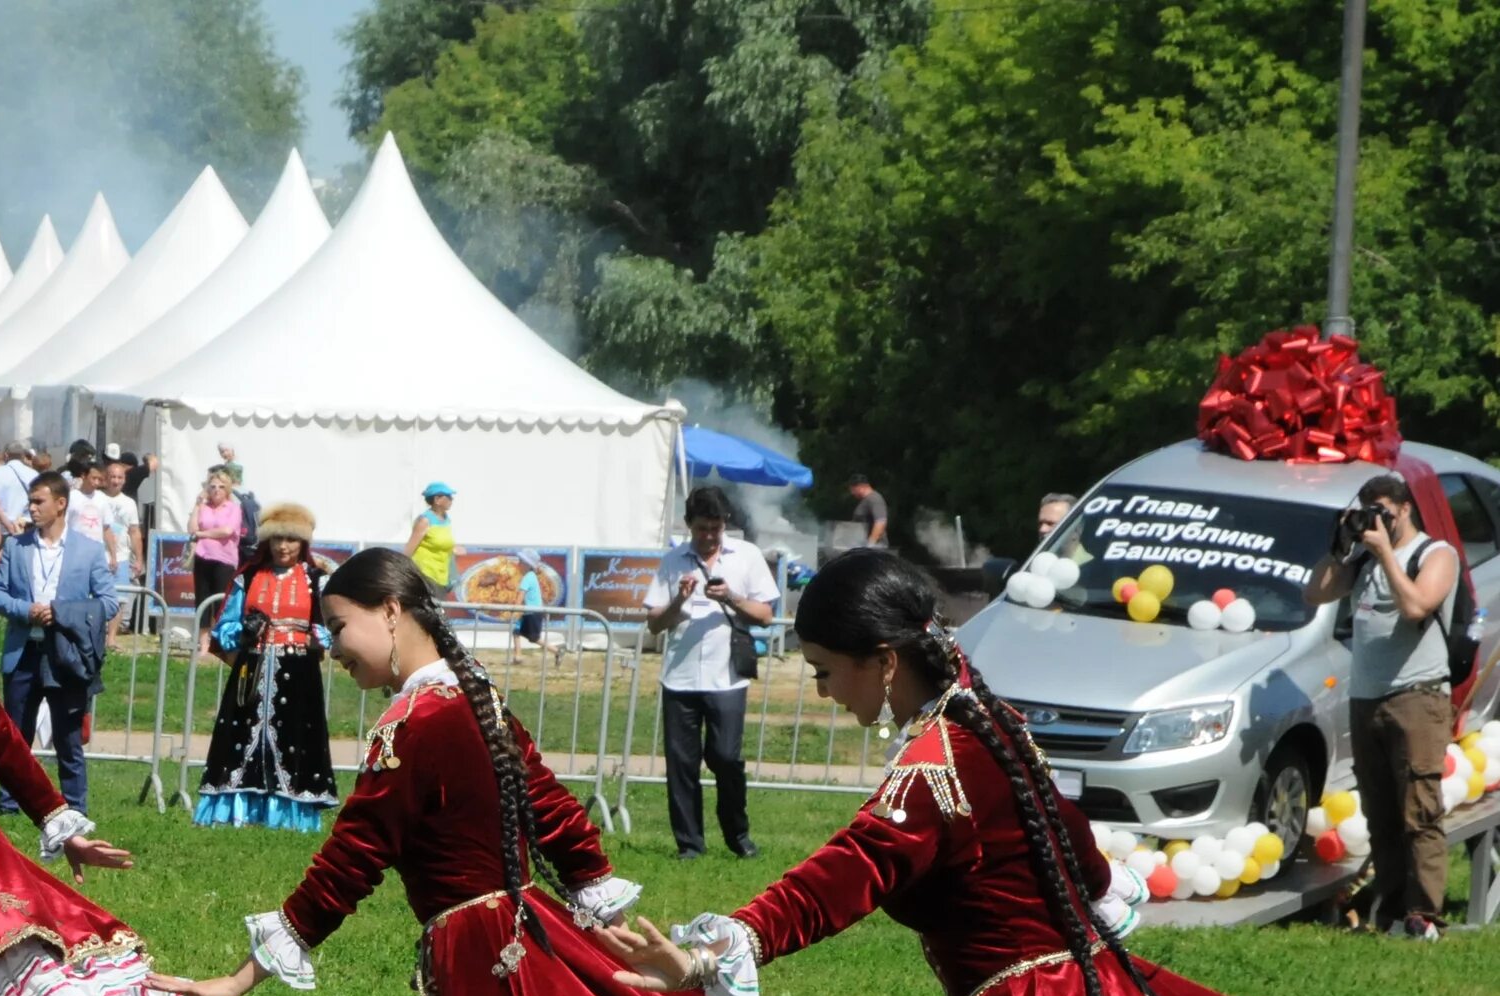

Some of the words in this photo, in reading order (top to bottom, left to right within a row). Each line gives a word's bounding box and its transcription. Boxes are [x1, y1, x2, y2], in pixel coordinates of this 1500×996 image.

[1083, 496, 1122, 515] От
[1123, 494, 1220, 522] Главы
[1095, 518, 1276, 552] Республики
